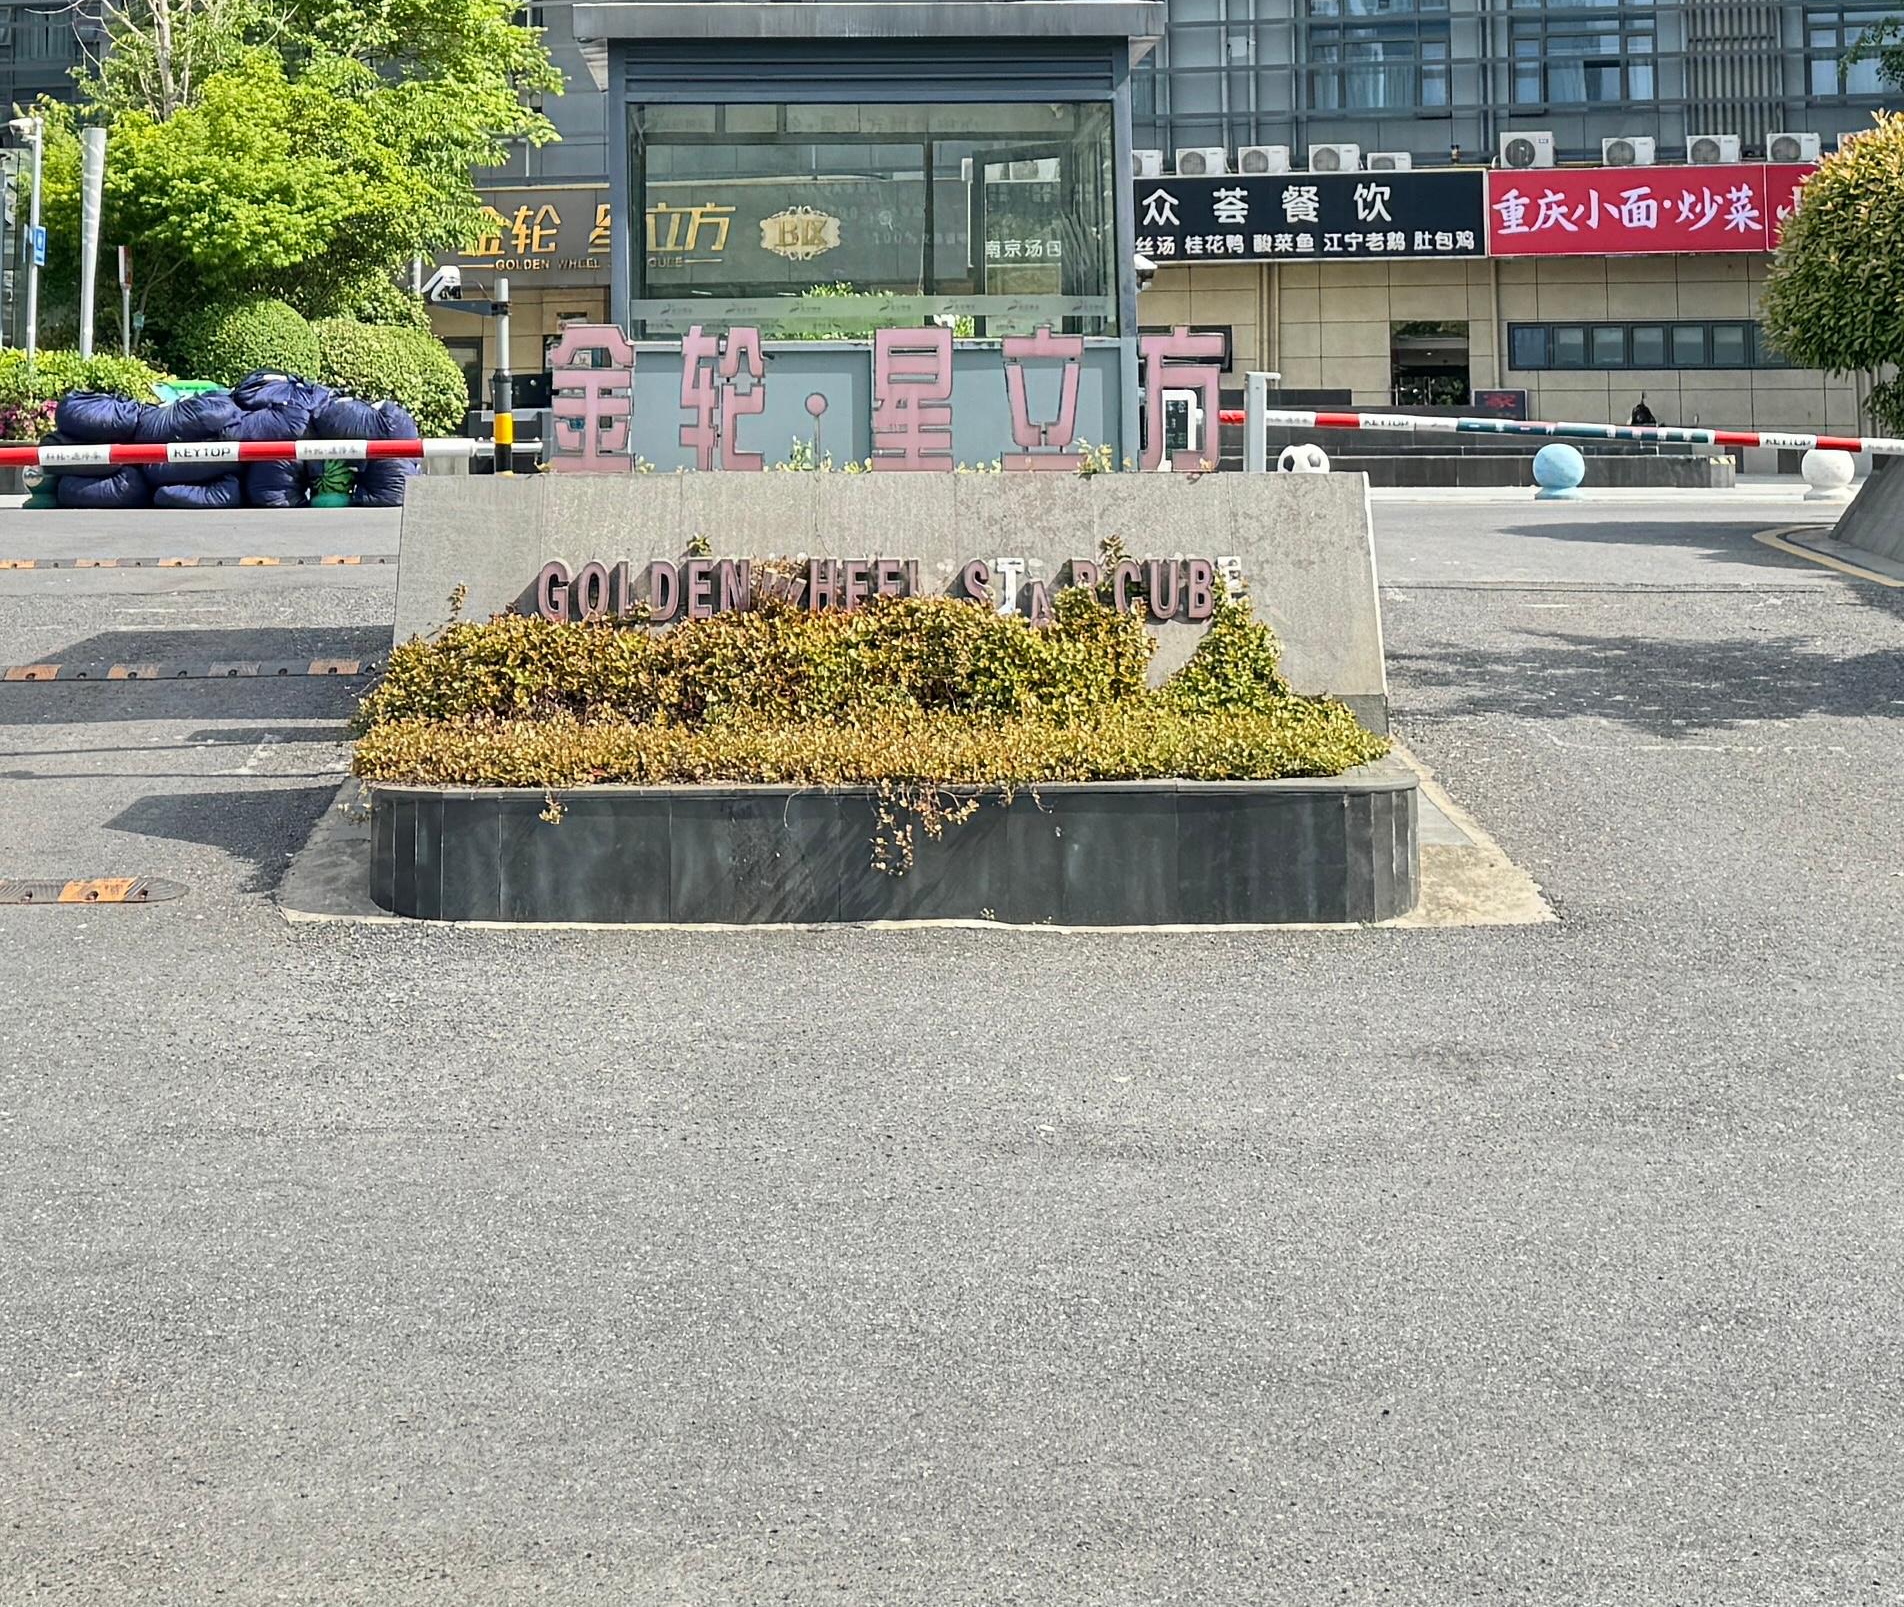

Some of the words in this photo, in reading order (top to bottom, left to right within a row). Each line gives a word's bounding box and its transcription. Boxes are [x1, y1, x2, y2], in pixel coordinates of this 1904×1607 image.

[1142, 182, 1392, 226] 众荟餐饮
[1493, 183, 1763, 235] 重庆小面·炒菜
[495, 258, 550, 271] GOLDEN
[1135, 236, 1175, 256] 丝汤
[1184, 235, 1245, 255] 桂花鸭
[1253, 233, 1315, 253] 酸菜鱼
[1324, 232, 1405, 252] 江宁老鹅
[1413, 231, 1475, 251] 肚包鸡
[537, 557, 752, 623] GOLDEN
